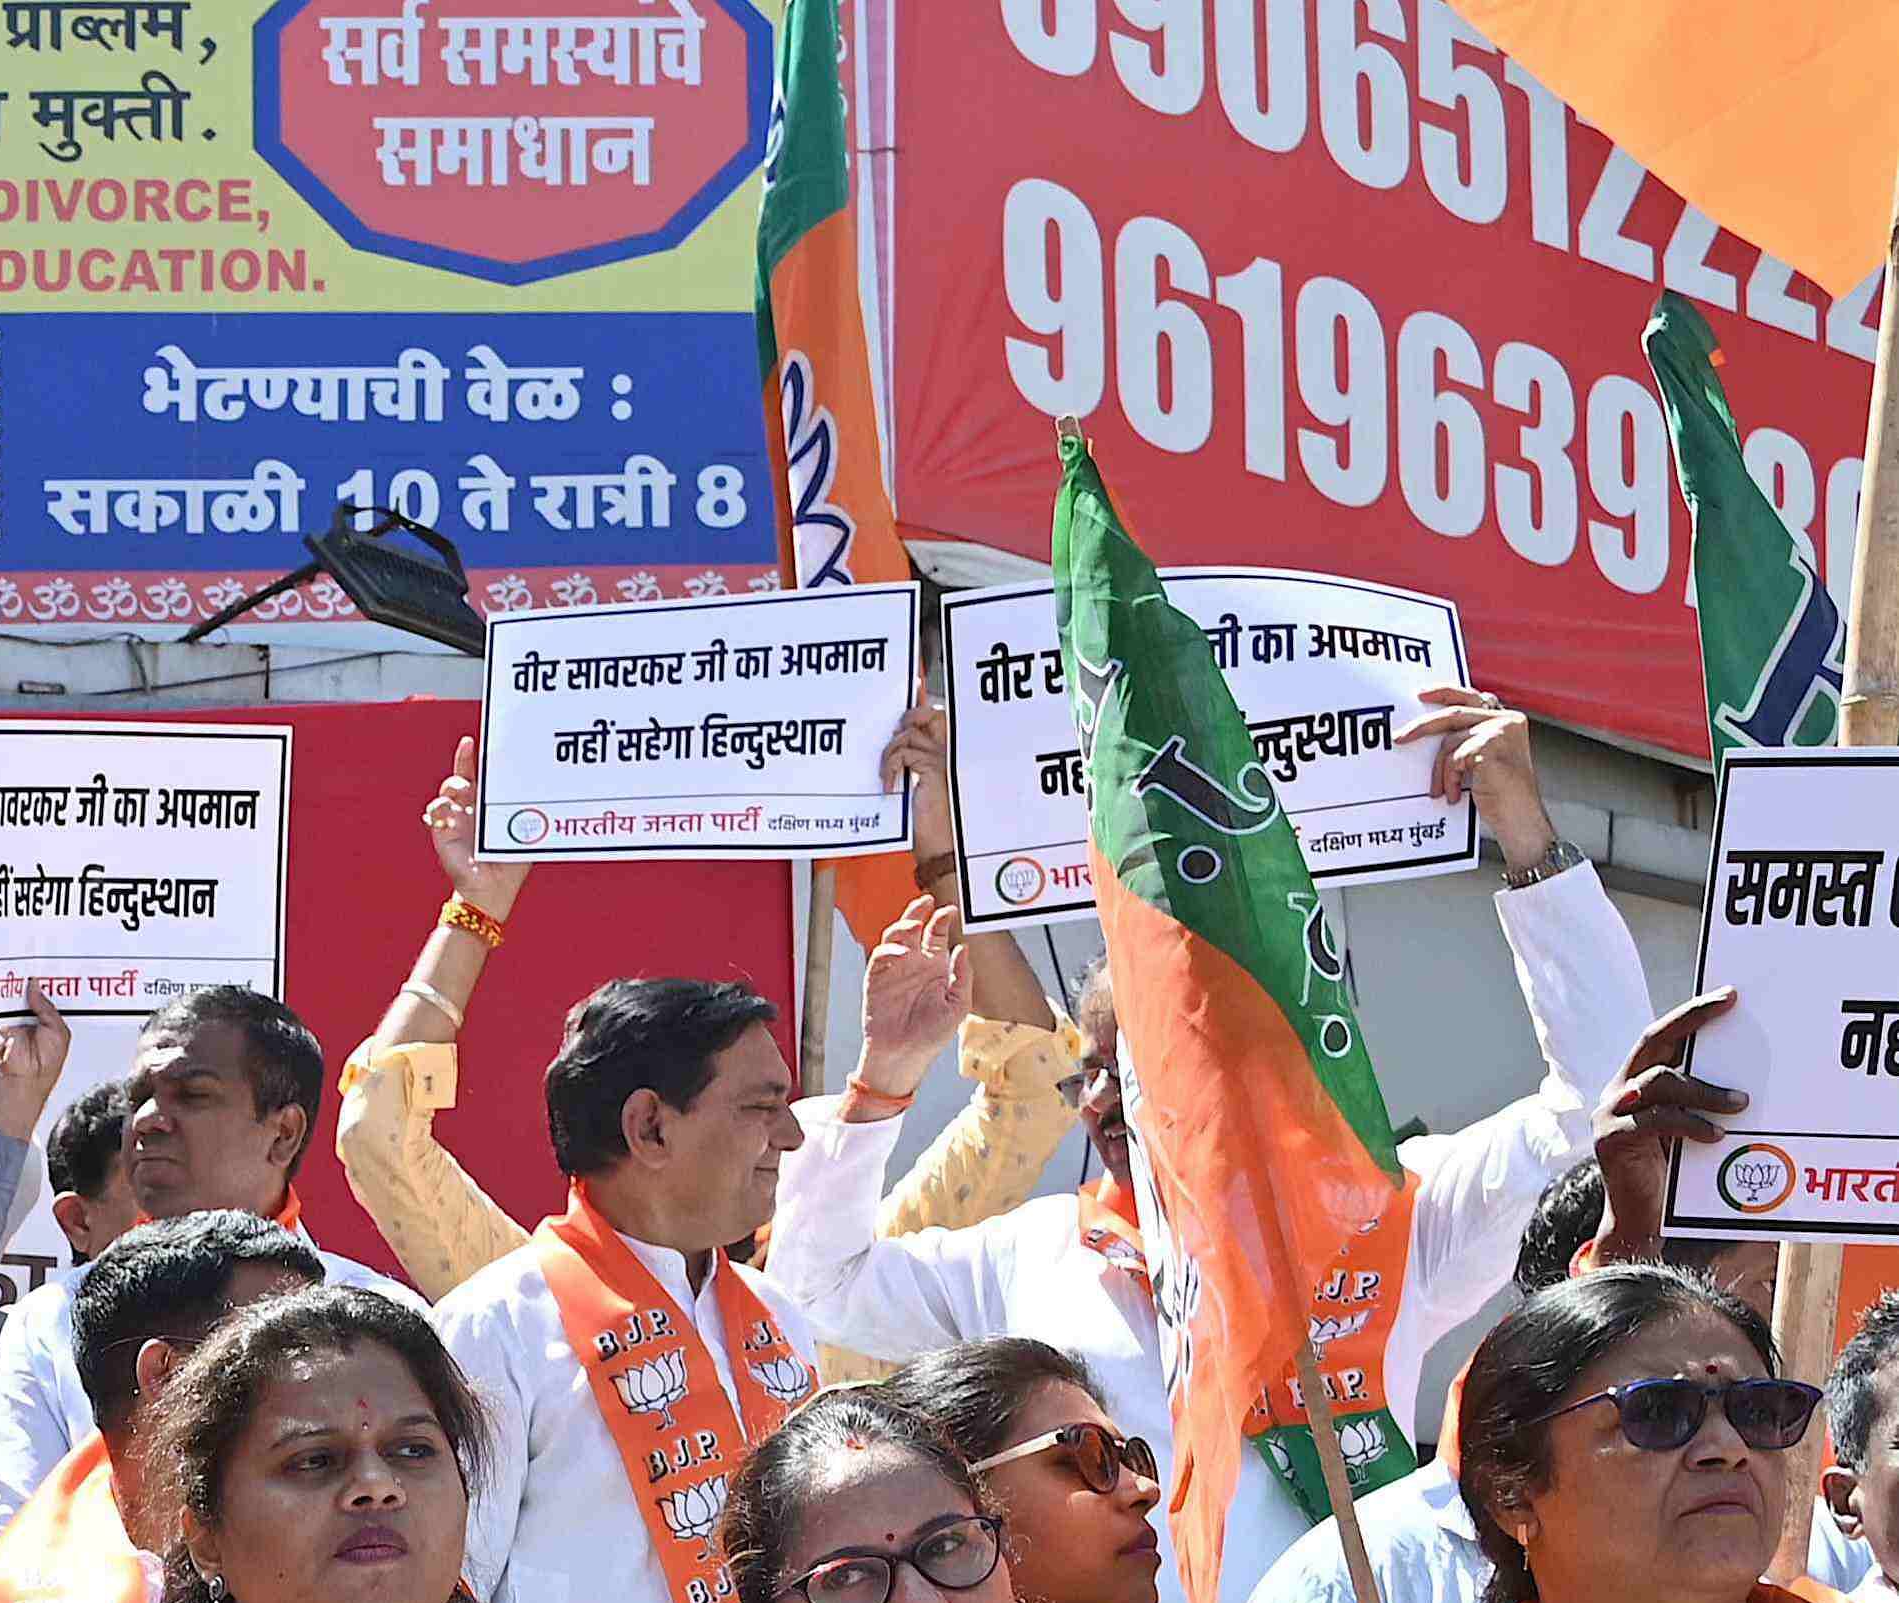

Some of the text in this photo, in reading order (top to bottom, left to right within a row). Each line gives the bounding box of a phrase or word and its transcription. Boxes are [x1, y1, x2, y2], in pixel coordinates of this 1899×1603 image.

[373, 116, 654, 186] समाधान
[143, 345, 583, 422] भेटण्याची वेळ
[44, 454, 747, 535] सकाळी 10 ते रात्री 8
[512, 637, 888, 693] वीर सावरकर जी का अपमान
[976, 643, 1035, 704] वीर
[1249, 622, 1297, 667] का
[1308, 623, 1431, 668] अपमान
[554, 718, 615, 765] नहीं
[616, 716, 694, 762] सहेगा
[75, 774, 109, 827] जी
[114, 788, 149, 828] का
[156, 790, 260, 829] अपमान
[554, 811, 634, 837] भारतीय
[642, 812, 702, 834] जनता
[711, 806, 762, 833] पार्टी
[14, 863, 74, 916] सहेगा
[1726, 850, 1884, 927] समस्त
[88, 970, 139, 997] पार्टी
